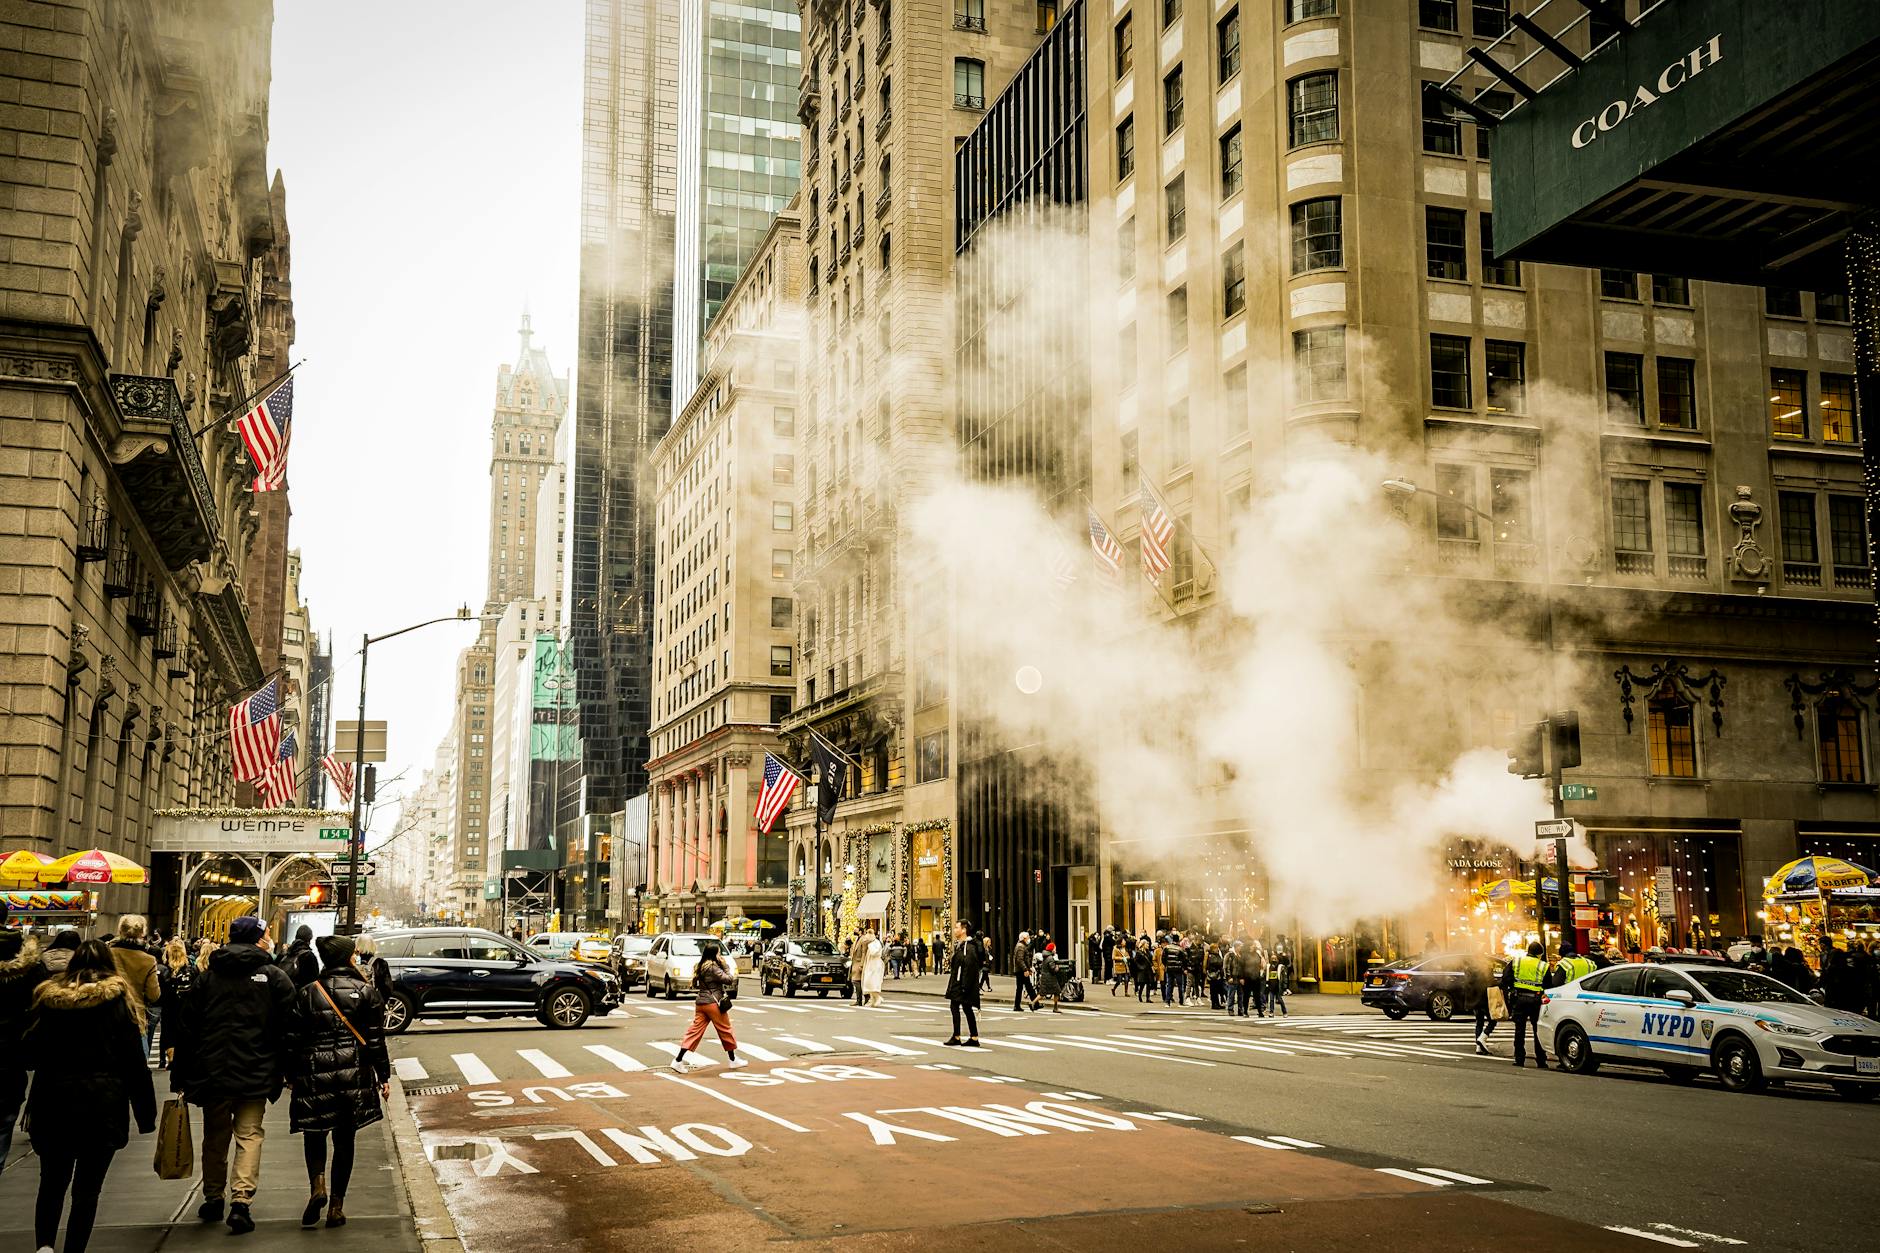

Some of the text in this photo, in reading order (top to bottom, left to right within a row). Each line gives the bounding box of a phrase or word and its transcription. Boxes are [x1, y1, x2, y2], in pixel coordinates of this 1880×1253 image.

[1571, 33, 1724, 149] COACH
[221, 820, 305, 832] WEMPE
[322, 830, 329, 838] W
[331, 830, 340, 838] 54
[1540, 825, 1568, 834] ONE WAY
[1473, 859, 1503, 868] GOOSE
[1822, 877, 1865, 888] SABRETT
[1642, 1012, 1696, 1039] NYPD
[719, 1065, 897, 1087] BUS
[467, 1082, 631, 1107] BUS
[842, 1101, 1142, 1145] ONLY
[480, 1123, 753, 1177] ONLY
